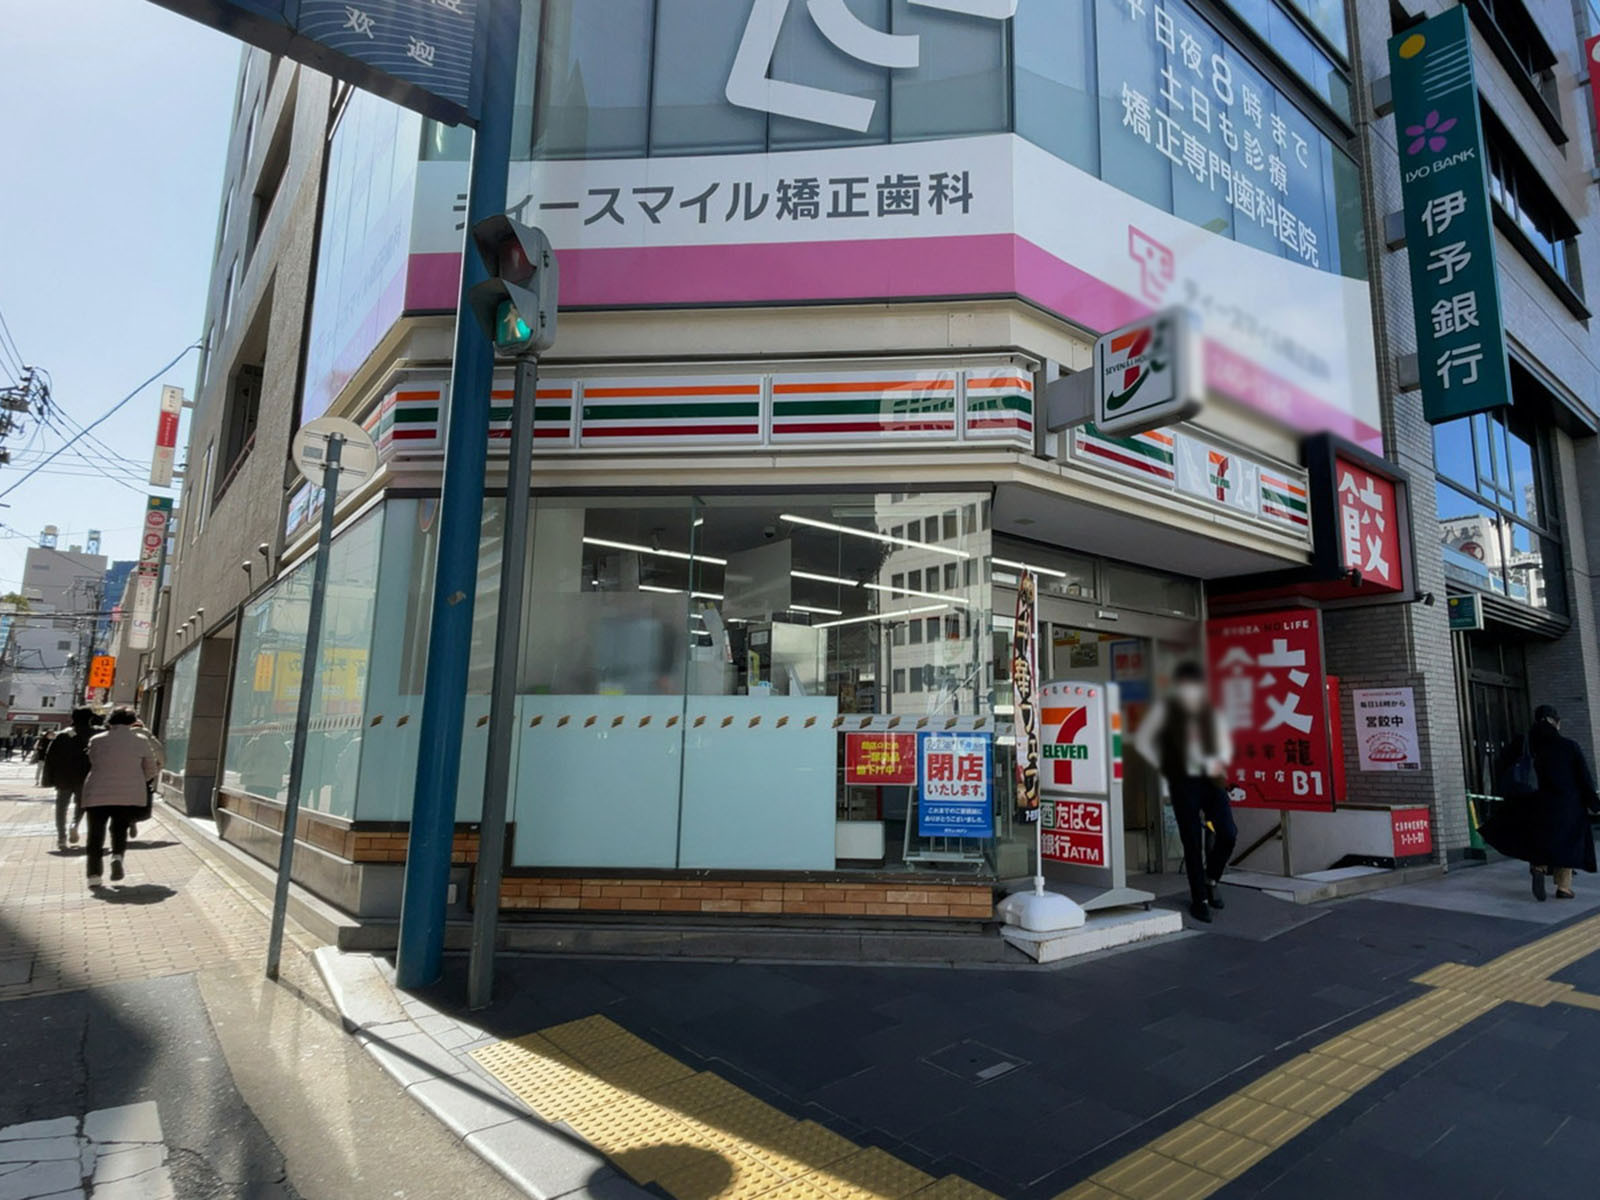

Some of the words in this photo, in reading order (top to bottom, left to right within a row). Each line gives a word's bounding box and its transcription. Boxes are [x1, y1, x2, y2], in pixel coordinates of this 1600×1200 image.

[1159, 64, 1289, 196] 土日も診療
[1122, 81, 1320, 269] 矯正専門歯科医院
[1405, 163, 1431, 183] IYO
[1432, 147, 1476, 174] BANK
[1421, 189, 1484, 390] 伊予銀行
[1338, 471, 1389, 581] 餃
[1283, 619, 1309, 631] LIFE
[927, 753, 984, 782] 閉店
[1292, 770, 1323, 796] B1
[927, 784, 984, 797] いたします。
[1056, 803, 1101, 831] たばこ
